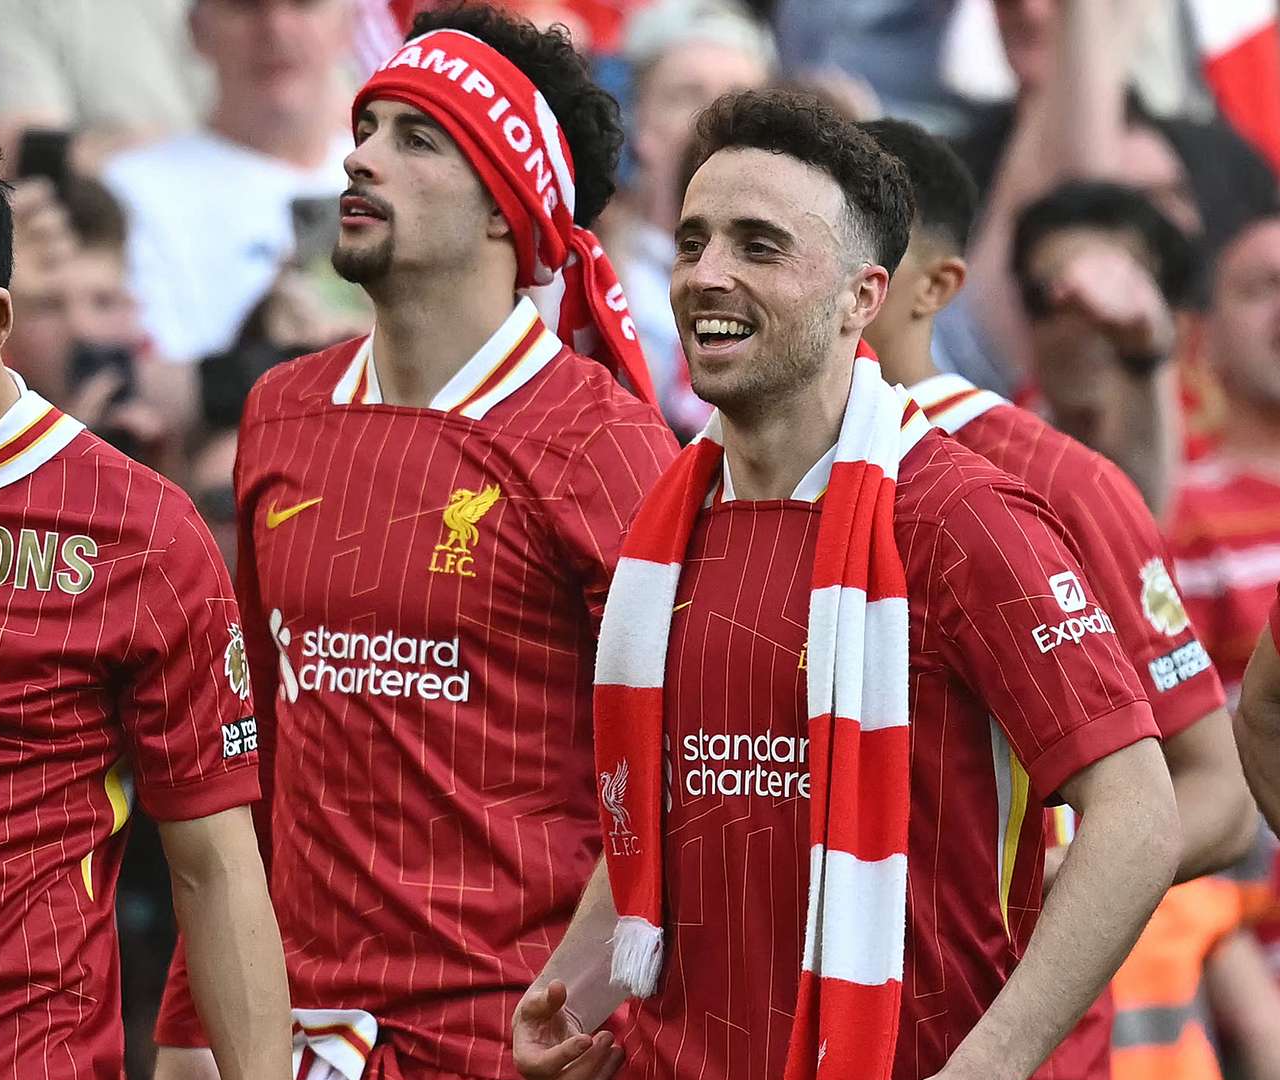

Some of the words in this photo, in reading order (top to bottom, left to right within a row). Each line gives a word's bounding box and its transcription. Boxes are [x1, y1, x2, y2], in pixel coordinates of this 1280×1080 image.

[378, 45, 559, 219] AMPIONS
[302, 624, 460, 668] standard
[297, 657, 471, 703] chartered
[683, 727, 810, 763] standar
[685, 761, 811, 799] chartere
